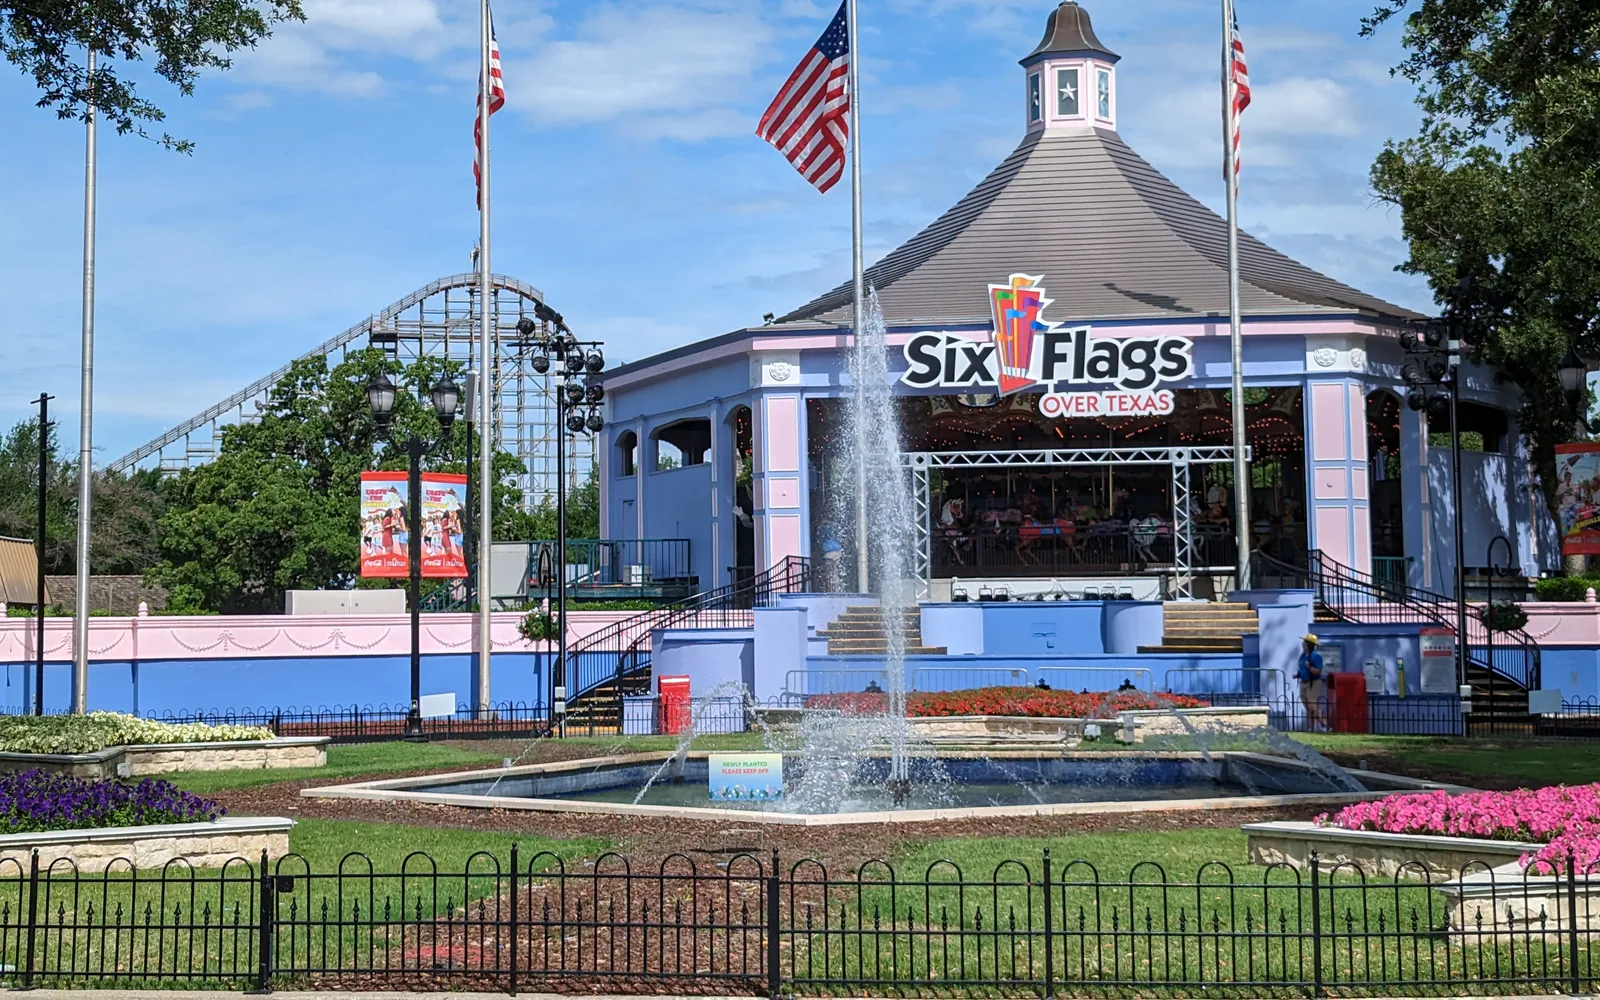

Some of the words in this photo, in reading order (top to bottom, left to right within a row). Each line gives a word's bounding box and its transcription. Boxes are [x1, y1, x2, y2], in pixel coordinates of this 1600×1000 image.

[906, 334, 996, 384] Six
[1041, 329, 1188, 389] Flags
[1042, 395, 1098, 414] OVER
[1105, 393, 1170, 412] TEXAS
